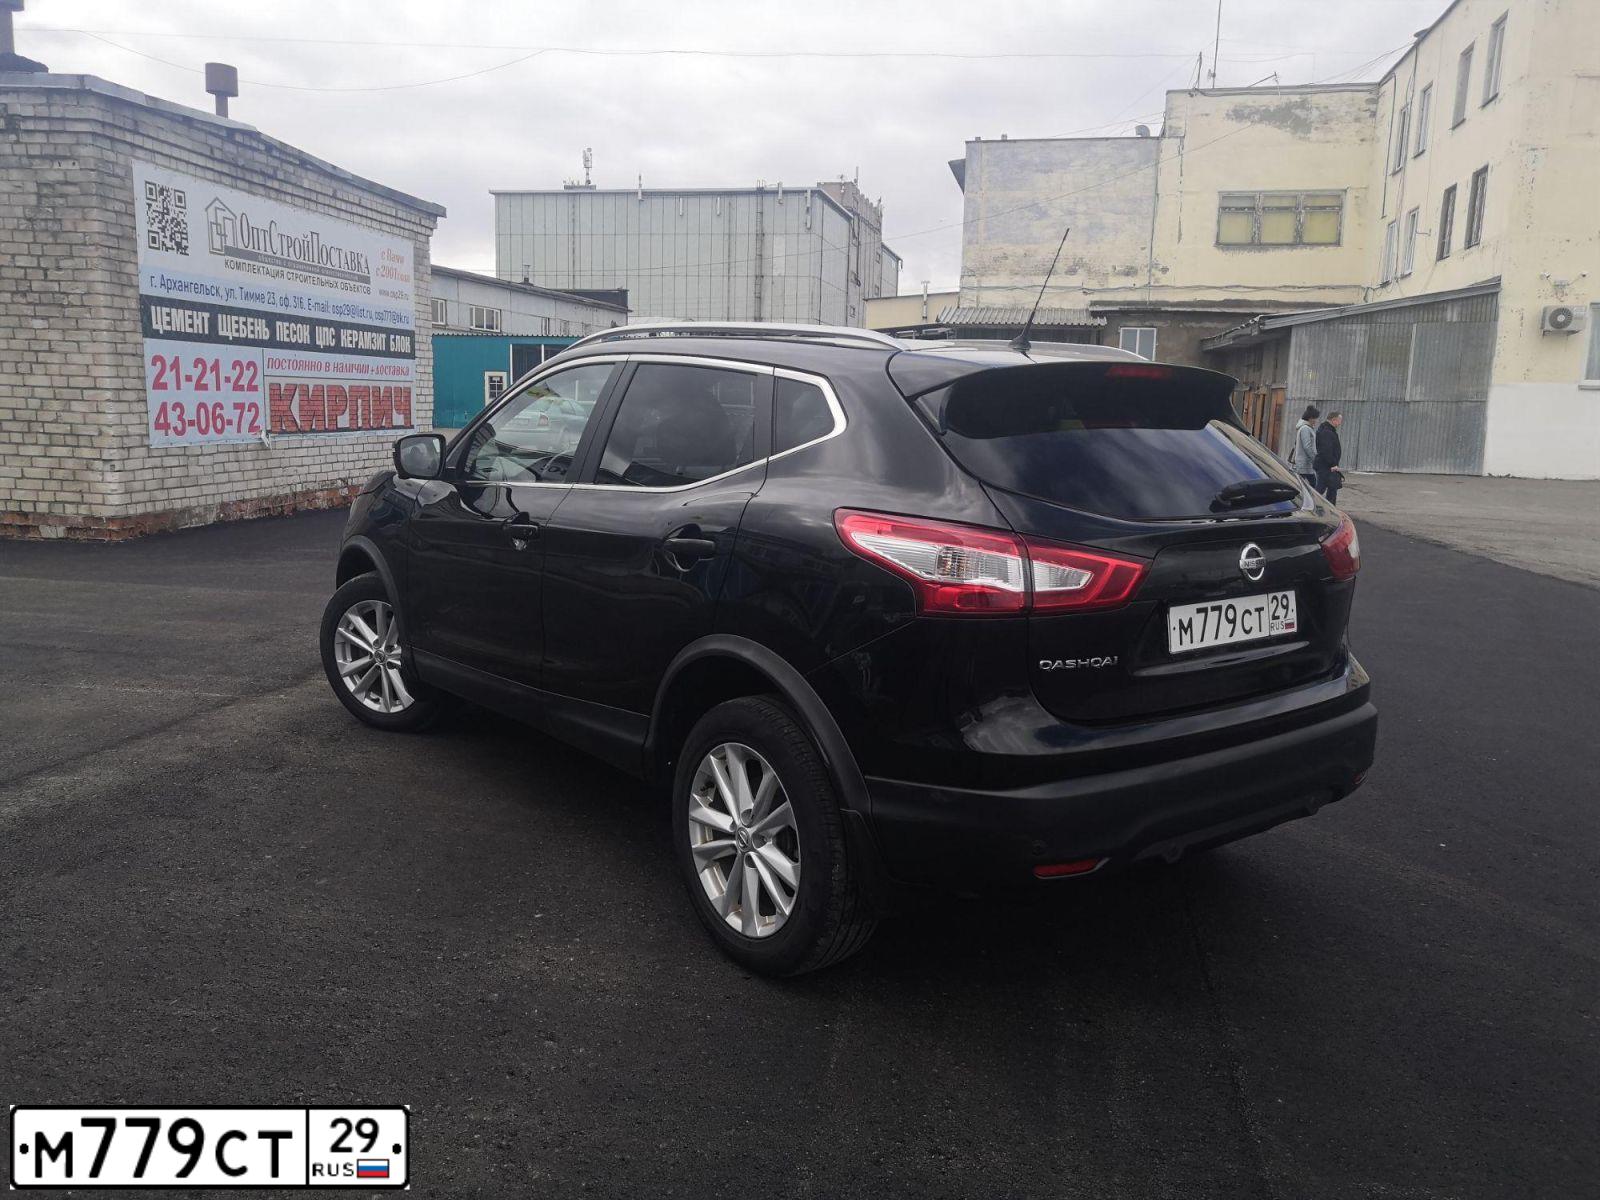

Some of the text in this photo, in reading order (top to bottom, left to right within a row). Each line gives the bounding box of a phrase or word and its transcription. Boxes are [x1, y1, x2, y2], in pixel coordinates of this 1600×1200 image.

[160, 274, 223, 300] Архангельск,
[225, 287, 238, 302] ул.
[239, 286, 266, 304] Тимме
[224, 258, 285, 280] КОМПЛЕКТАЦИЯ
[286, 271, 339, 289] СТРОИТЕЛЬНЫХ
[340, 281, 371, 295] ОБЪЕКТОВ
[151, 305, 411, 353] ЦЕМЕНТ ЩЕБЕНЬ ПЕСОК ЦПС КЕРАМЗИТ БЛОК
[151, 354, 259, 392] 21-21-22
[154, 401, 261, 437] 43-06-72
[269, 382, 412, 433] КИРПИЧ
[1270, 593, 1290, 621] 29
[1270, 620, 1285, 630] RUS
